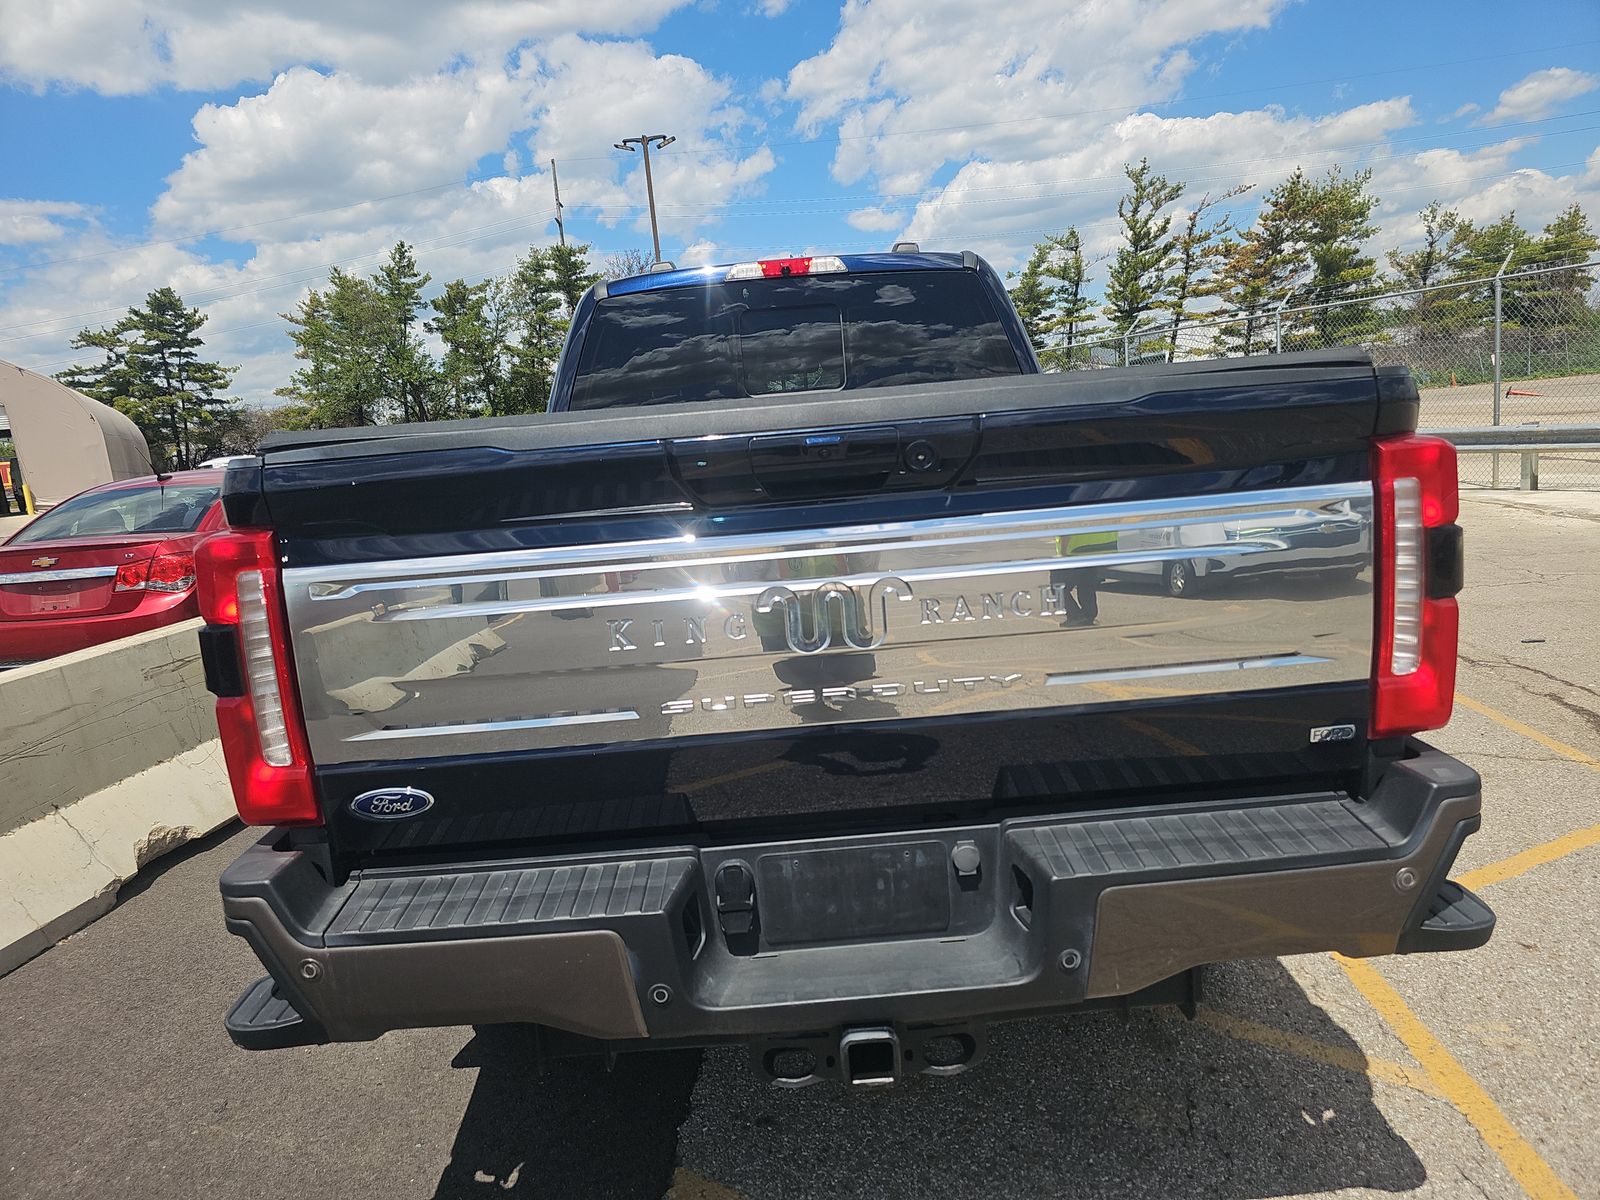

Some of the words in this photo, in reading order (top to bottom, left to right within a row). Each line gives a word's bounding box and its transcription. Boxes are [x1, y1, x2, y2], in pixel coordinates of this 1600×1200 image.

[605, 611, 748, 652] KING
[918, 583, 1068, 626] RANCH
[660, 686, 858, 715] SUPER
[872, 673, 1023, 698] DUTY
[370, 795, 414, 813] Ford
